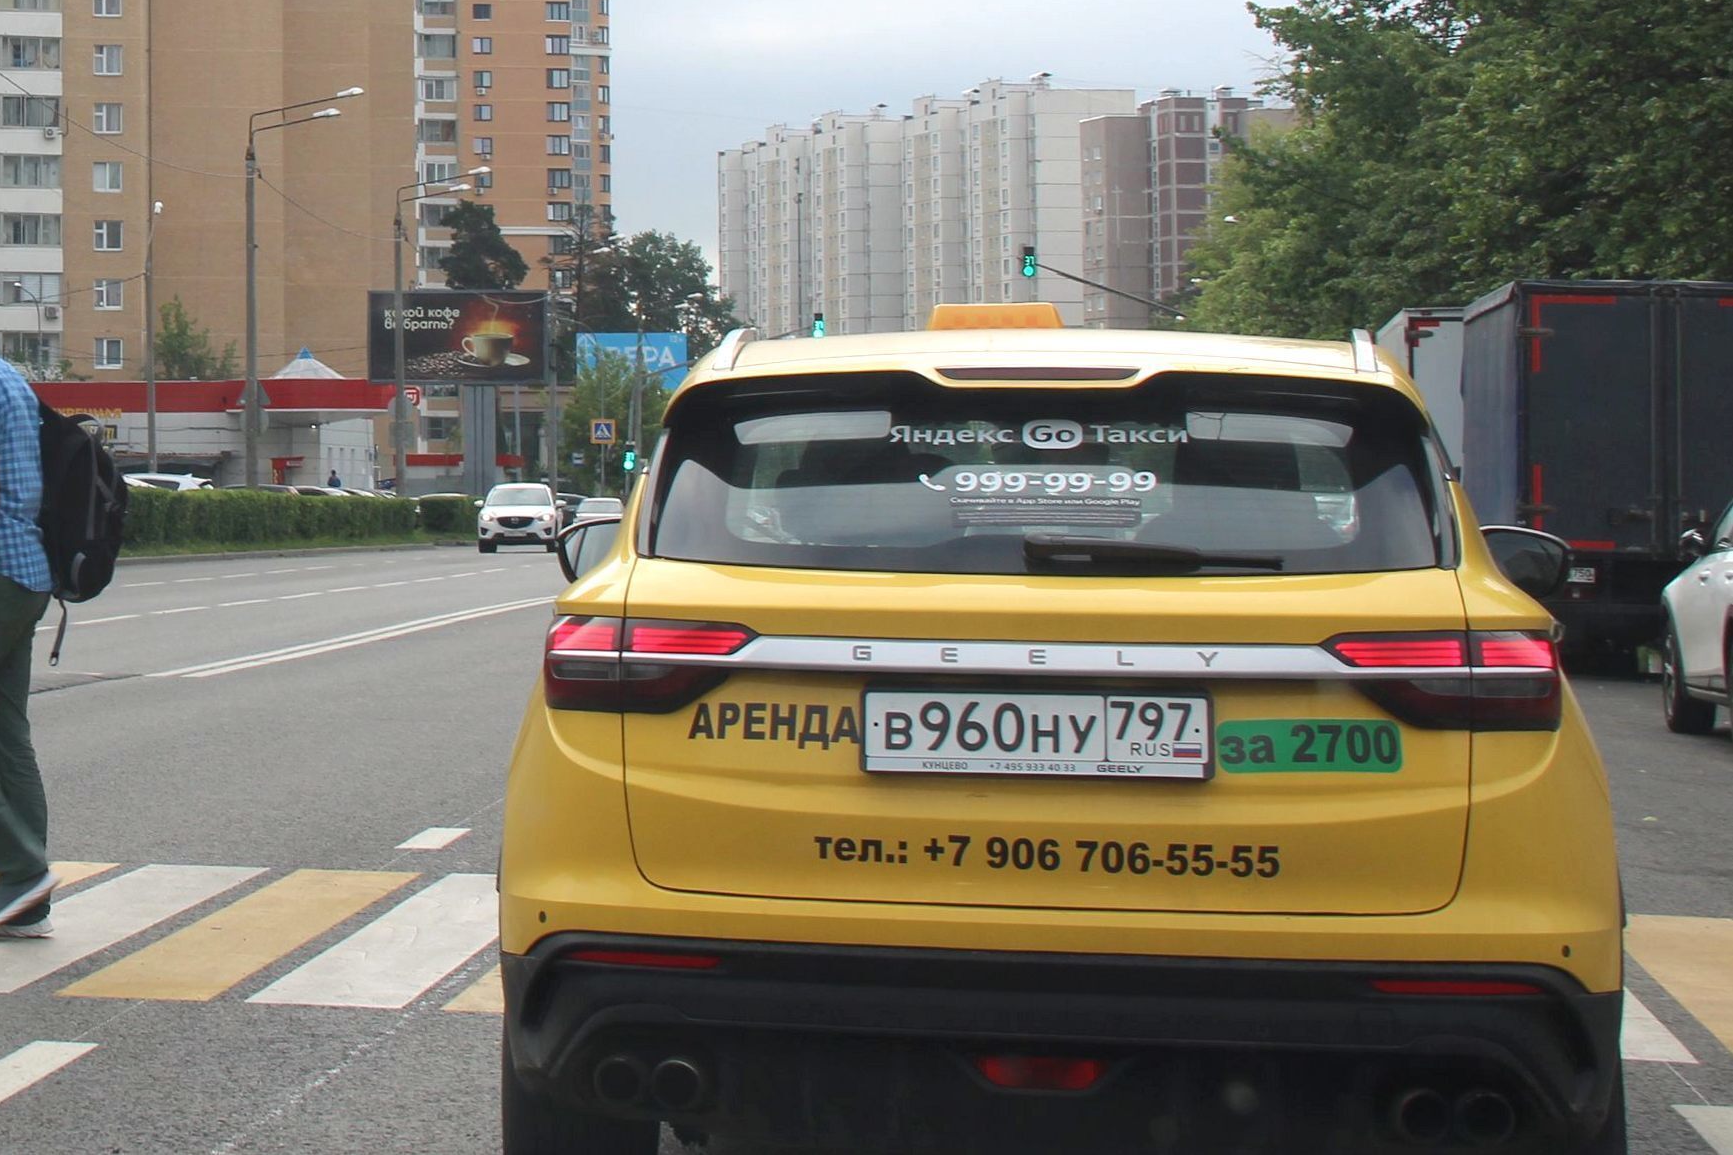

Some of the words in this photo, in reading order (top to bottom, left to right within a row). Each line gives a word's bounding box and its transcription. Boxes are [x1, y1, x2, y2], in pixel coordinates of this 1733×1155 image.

[428, 307, 460, 322] кофе
[890, 425, 1014, 445] Яндекс
[1031, 424, 1080, 443] Go
[1090, 425, 1188, 443] Такси
[955, 471, 1156, 493] 999-99-99
[852, 645, 1218, 667] GEELY
[688, 702, 860, 750] АРЕНДА
[1110, 701, 1192, 741] 797
[1130, 742, 1171, 757] RUS
[1220, 734, 1275, 764] за
[1291, 724, 1397, 764] 2700
[922, 761, 968, 771] КУНЦЕВО
[1096, 765, 1144, 773] GEELY
[814, 836, 908, 864] тел.:
[924, 835, 971, 867] +7
[985, 837, 1061, 871] 906
[1075, 840, 1280, 878] 706-55-55
